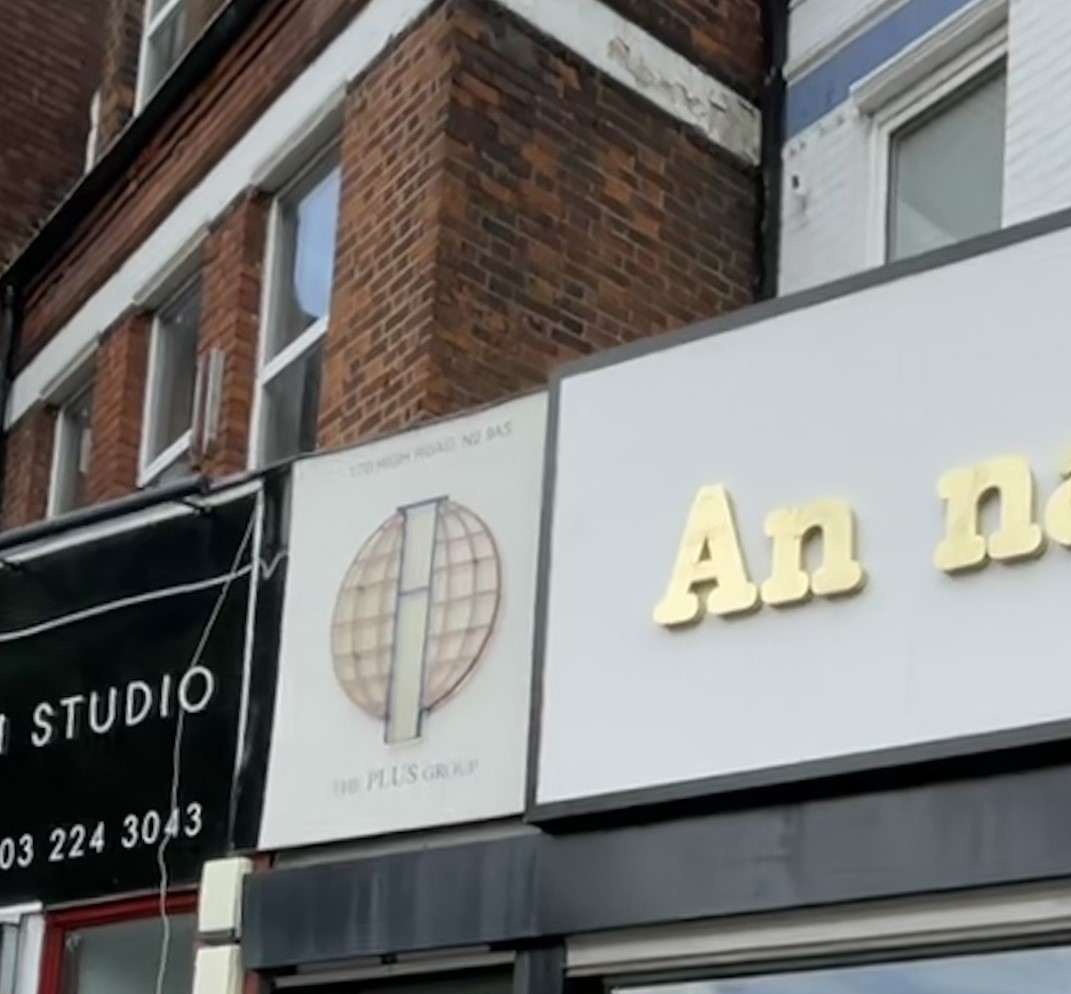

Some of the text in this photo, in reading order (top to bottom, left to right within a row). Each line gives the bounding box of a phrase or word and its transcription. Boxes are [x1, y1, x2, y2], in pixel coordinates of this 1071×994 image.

[652, 484, 868, 630] An
[31, 665, 215, 748] STUDIO
[366, 762, 419, 791] PLUS
[421, 759, 480, 782] GROUP
[48, 820, 106, 863] 224
[120, 801, 203, 850] 3043
